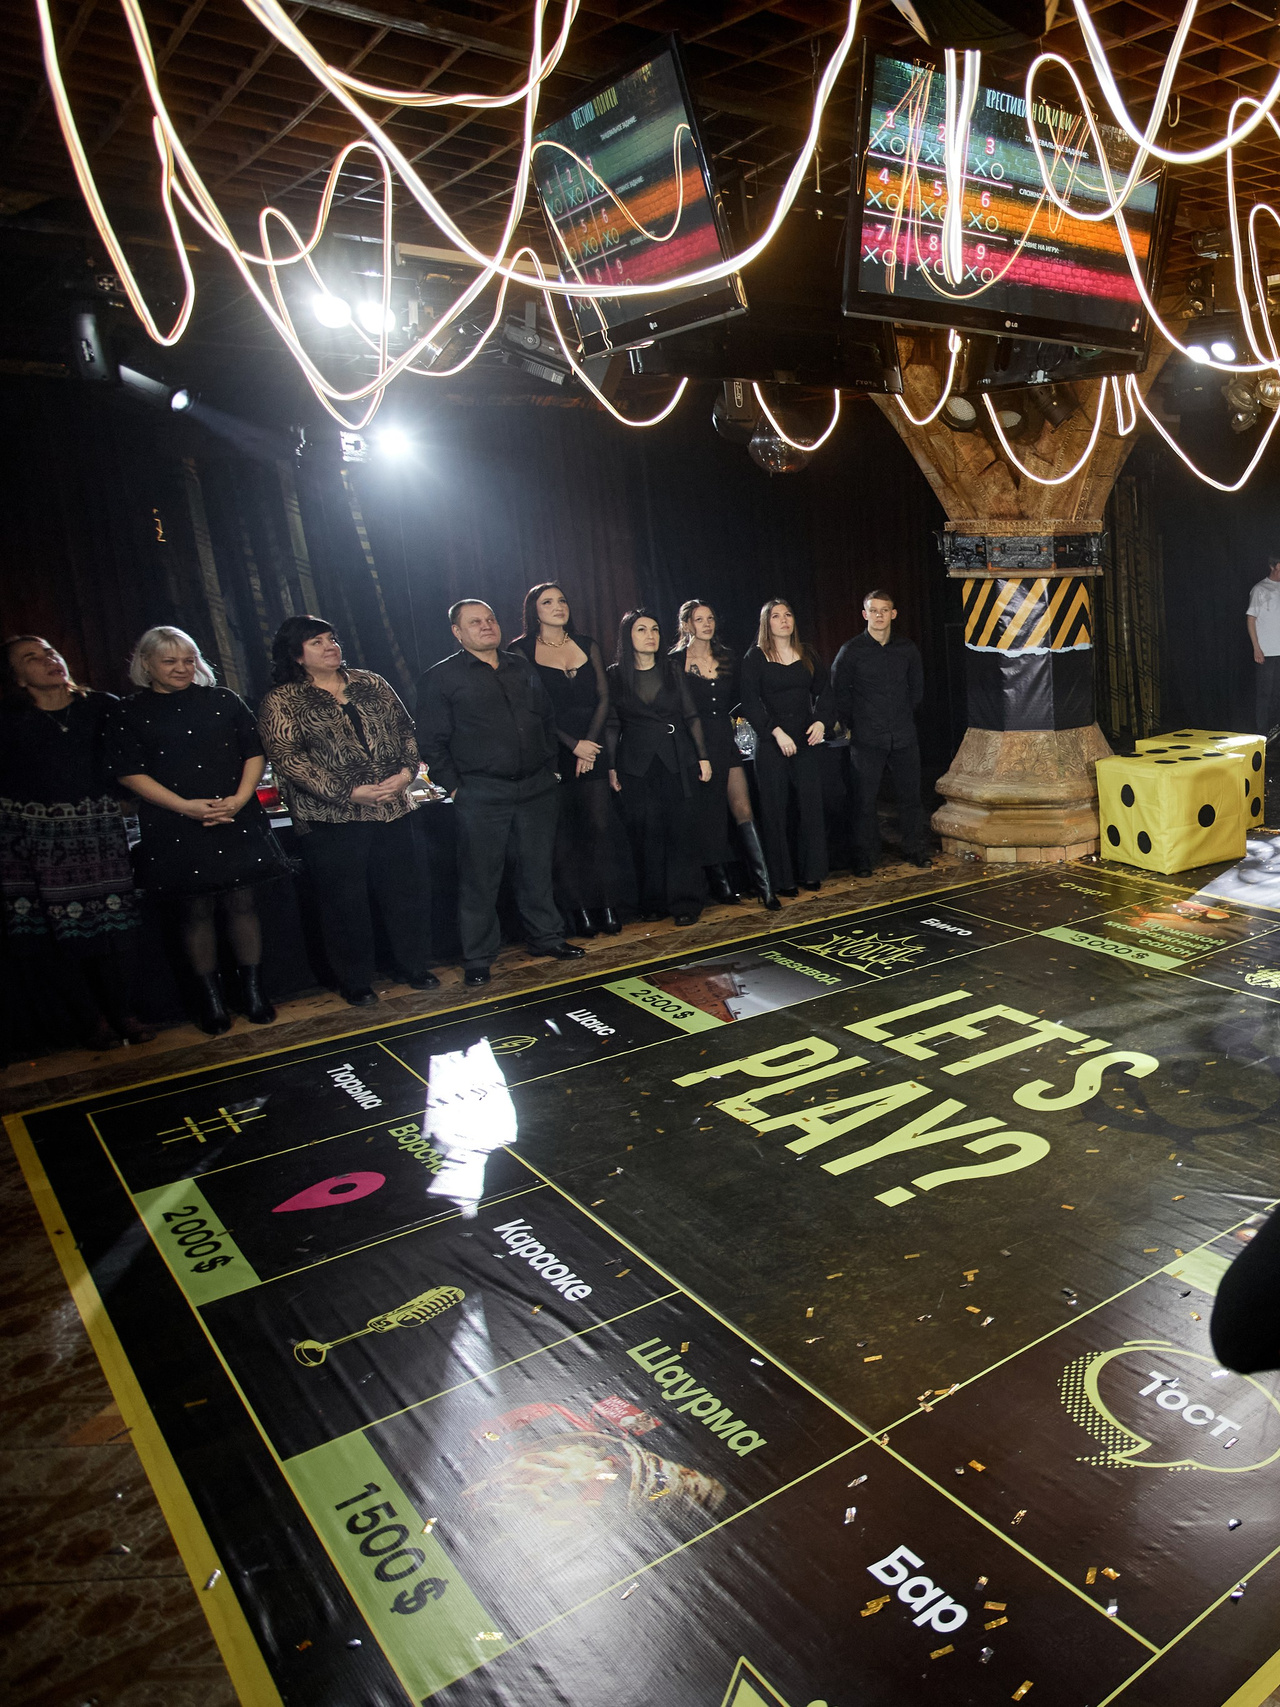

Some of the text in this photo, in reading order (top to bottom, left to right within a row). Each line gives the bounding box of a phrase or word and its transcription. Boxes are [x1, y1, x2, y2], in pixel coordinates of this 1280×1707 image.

[886, 111, 995, 155] 1 2 3
[1032, 102, 1073, 131] НОЛИКИ
[879, 169, 991, 207] 4 5 6
[601, 207, 608, 223] 6
[876, 225, 986, 260] 7 8 9
[1058, 882, 1112, 897] Старт
[919, 917, 973, 936] Бинго
[1103, 920, 1213, 952] массажный
[1140, 921, 1228, 946] Мужской
[1138, 938, 1197, 957] салон
[758, 950, 842, 986] Пивзавод
[565, 1008, 616, 1037] Шанс
[842, 989, 1161, 1113] LET'S
[326, 1063, 384, 1110] Тюрьма
[671, 1034, 1052, 1209] PLAY?
[162, 1206, 234, 1273] 2000$
[493, 1218, 593, 1301] Караоке
[625, 1337, 768, 1458] Шаурма
[1138, 1370, 1243, 1439] Тост
[335, 1482, 449, 1615] 1500$
[866, 1544, 968, 1633] Бар
